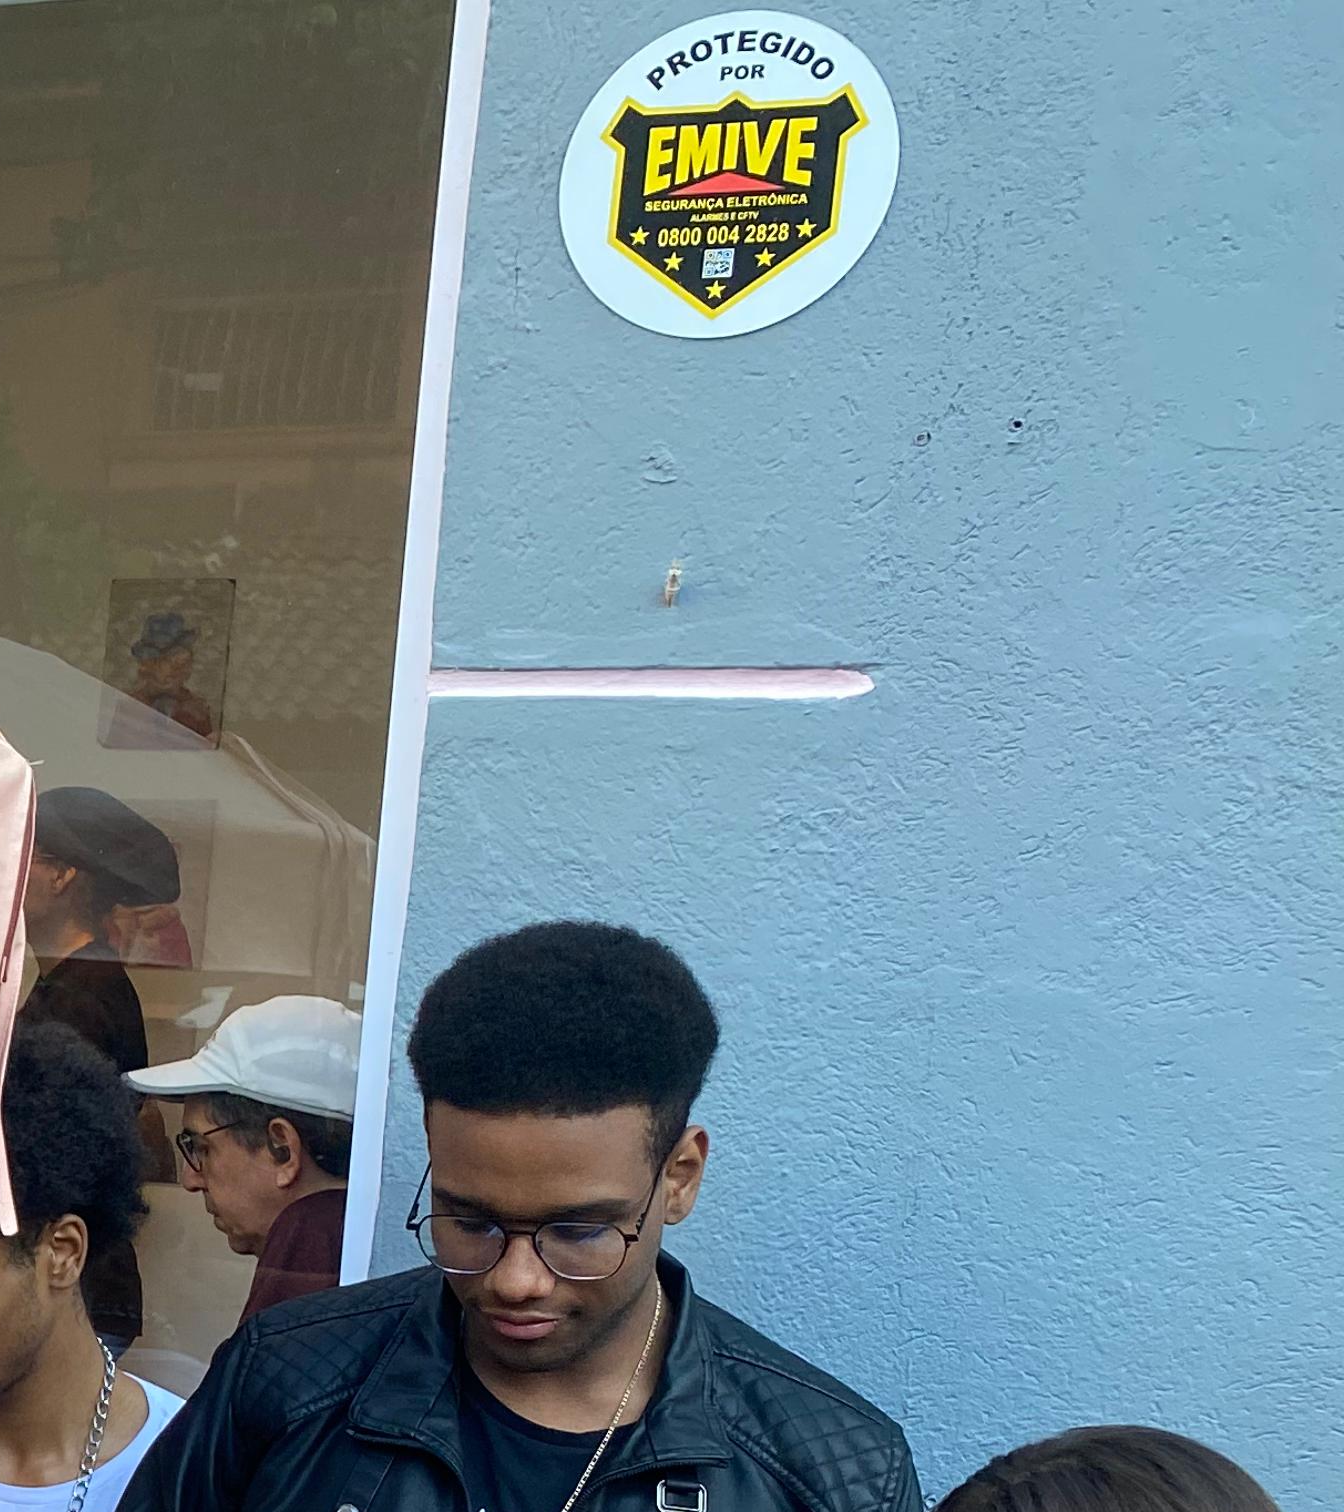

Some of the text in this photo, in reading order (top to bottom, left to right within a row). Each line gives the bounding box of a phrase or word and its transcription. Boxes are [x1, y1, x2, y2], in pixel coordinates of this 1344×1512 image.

[646, 30, 835, 90] PROTEGIDO
[720, 65, 765, 81] POR
[643, 116, 818, 197] EMIVE
[644, 193, 808, 213] SEGURANÇA ELETRÔNICA
[657, 223, 790, 248] 0800 004 2828
